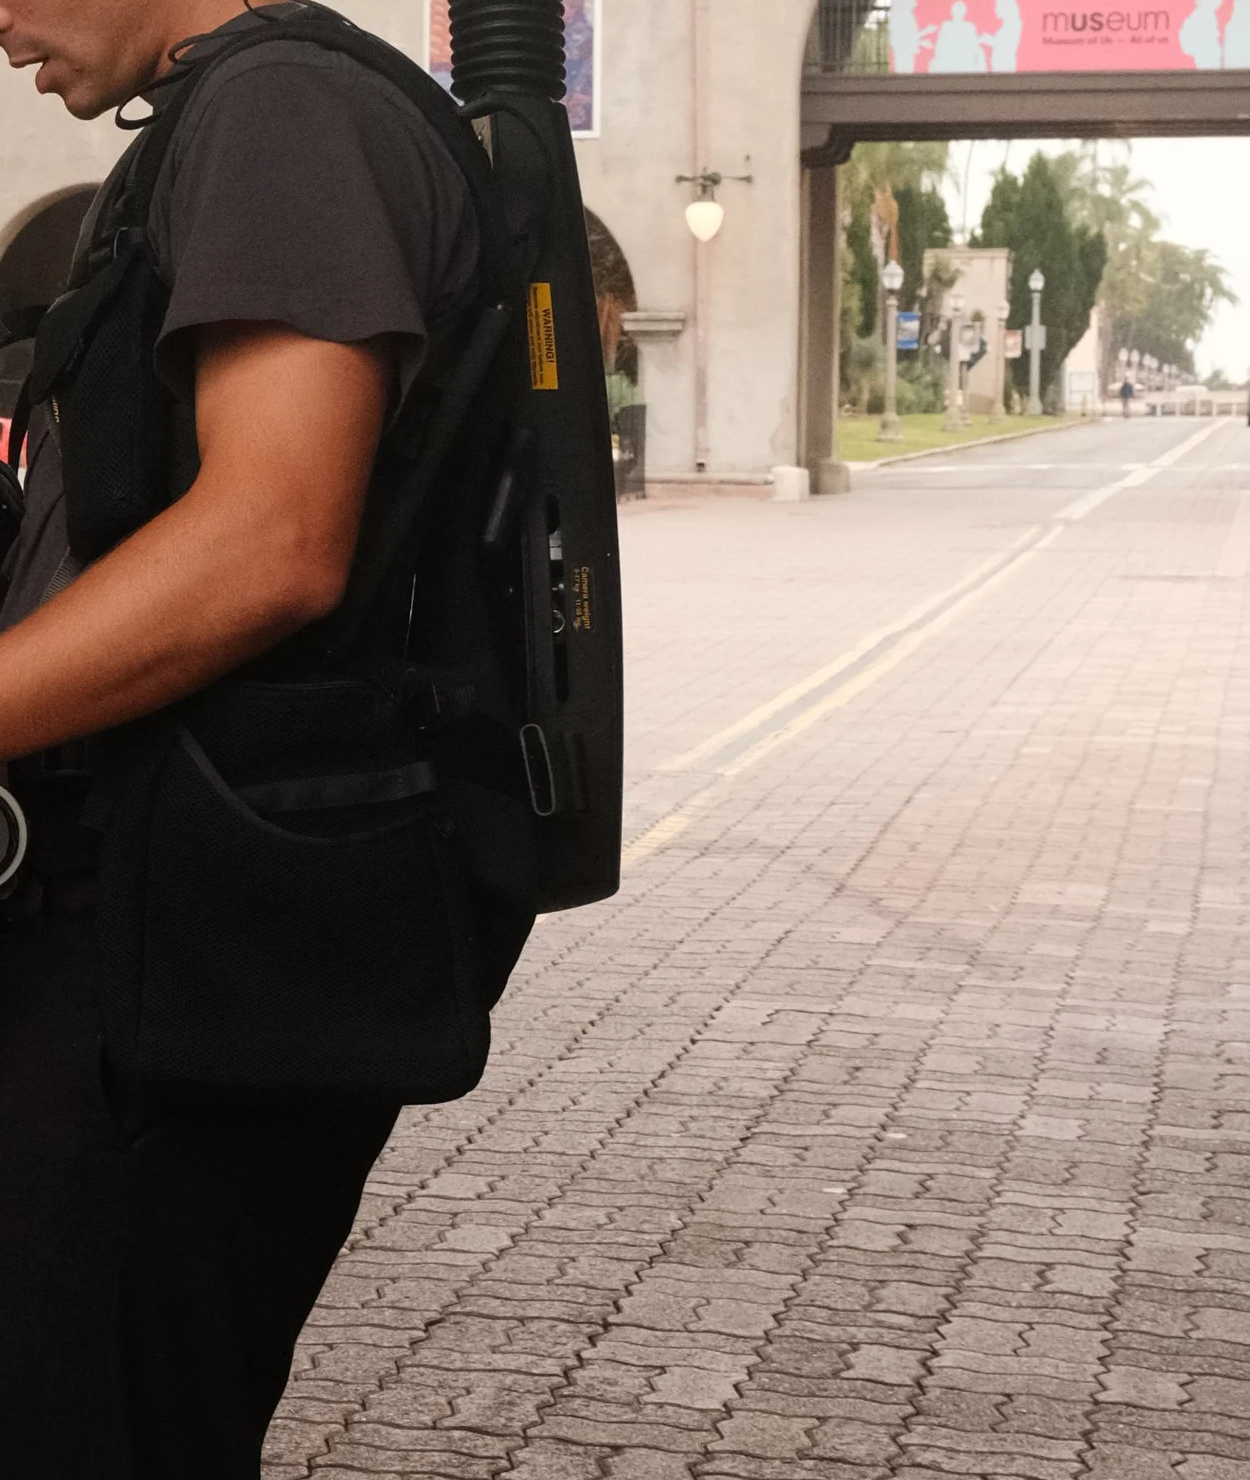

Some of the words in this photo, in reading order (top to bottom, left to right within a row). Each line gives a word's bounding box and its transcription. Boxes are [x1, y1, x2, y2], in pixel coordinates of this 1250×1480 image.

[1042, 10, 1170, 32] museum
[542, 308, 555, 363] WARNING!
[581, 566, 590, 599] Camera
[582, 601, 592, 630] weight
